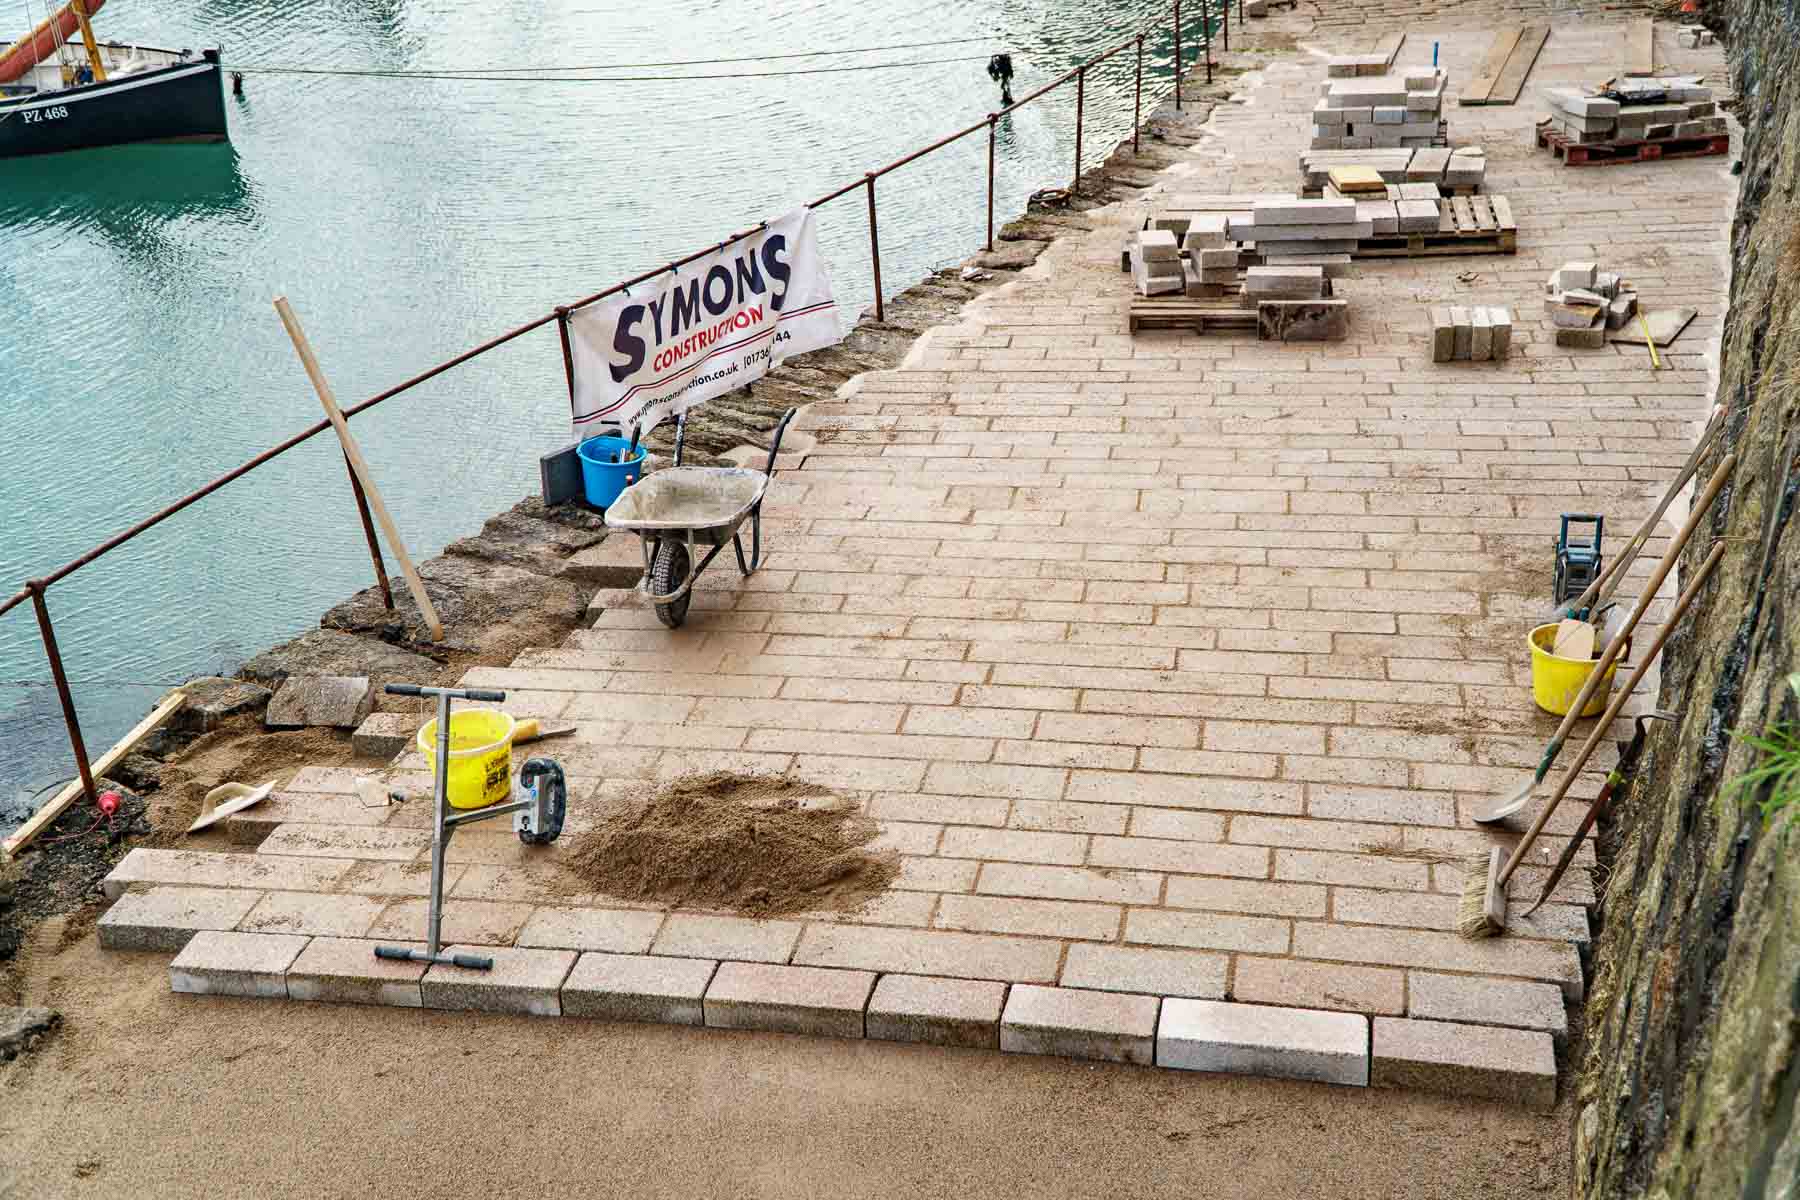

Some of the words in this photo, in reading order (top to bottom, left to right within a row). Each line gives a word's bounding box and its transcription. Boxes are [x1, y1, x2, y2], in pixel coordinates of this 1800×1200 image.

[21, 109, 43, 124] PZ
[44, 106, 69, 120] 468
[608, 234, 791, 383] SYMONS
[653, 304, 763, 372] CONSTRUCTION
